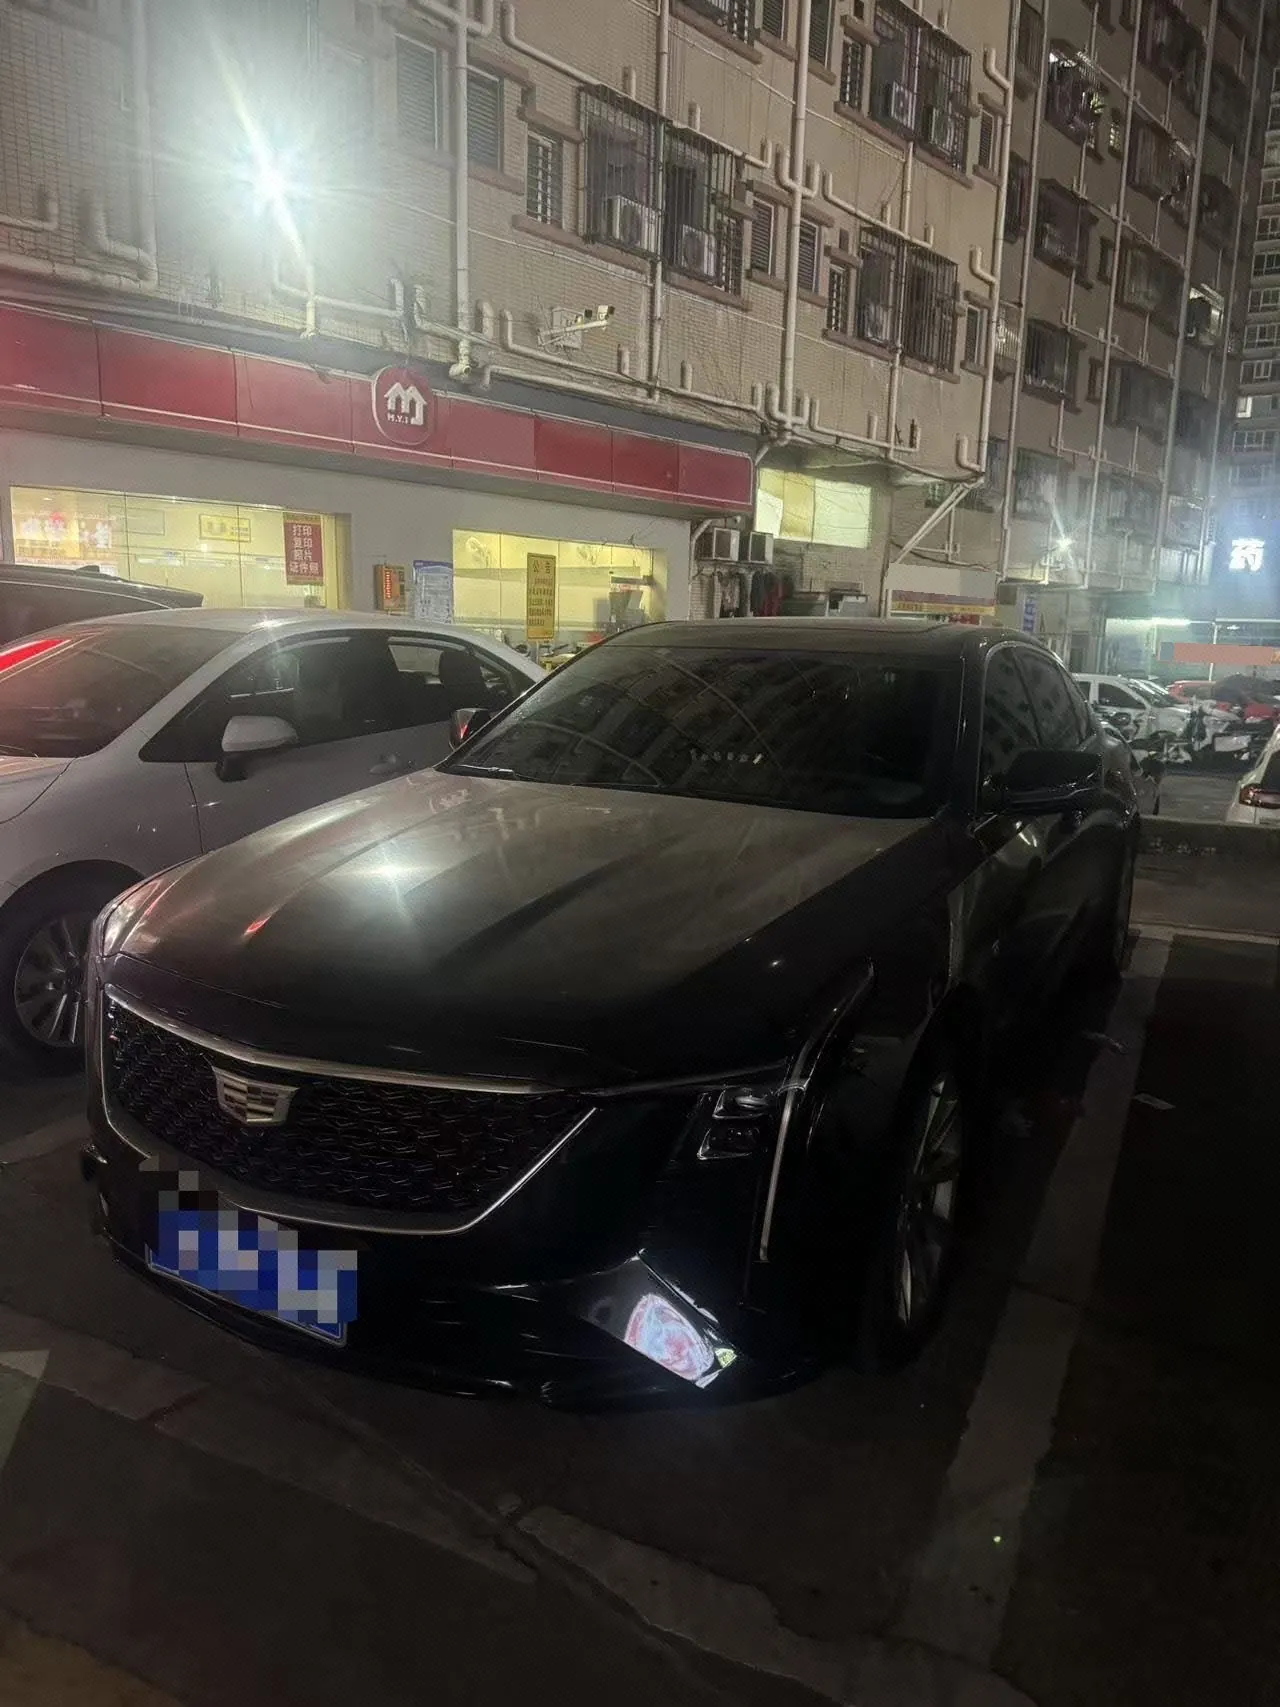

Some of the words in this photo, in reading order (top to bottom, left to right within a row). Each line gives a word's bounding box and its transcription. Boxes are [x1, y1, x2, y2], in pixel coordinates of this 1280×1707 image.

[292, 524, 312, 536] 打印
[292, 537, 313, 549] 复印
[1229, 537, 1266, 571] 药
[532, 559, 551, 574] 公告
